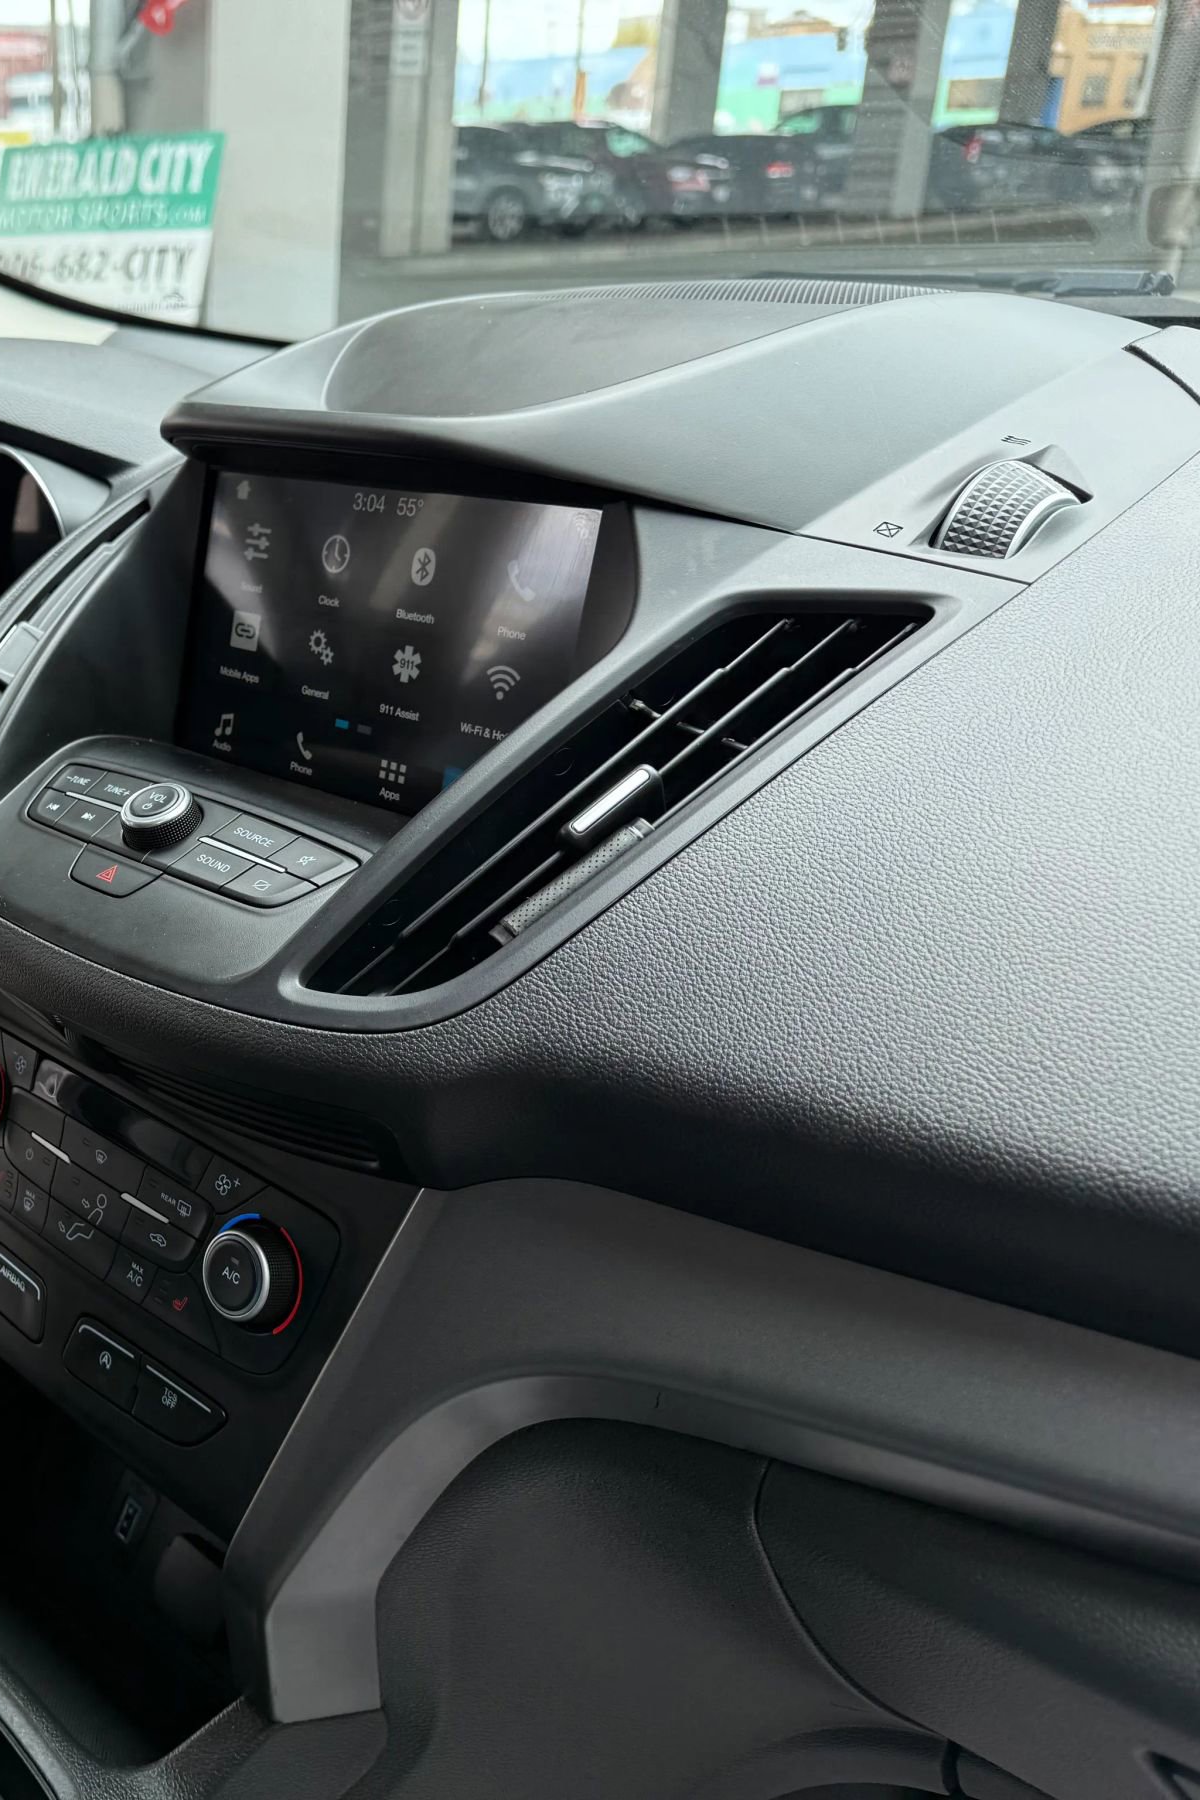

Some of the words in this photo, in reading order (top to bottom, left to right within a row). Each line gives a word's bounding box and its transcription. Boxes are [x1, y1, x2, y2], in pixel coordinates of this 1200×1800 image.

[5, 147, 138, 201] EMERALD
[138, 140, 215, 195] CITY
[352, 492, 386, 512] 3:04
[240, 581, 263, 593] Sound
[318, 595, 340, 607] Clock
[395, 608, 435, 624] Bluetooth
[497, 626, 527, 640] Phone
[400, 658, 415, 671] 911
[219, 666, 241, 680] Mobile
[241, 671, 260, 684] Apps
[301, 685, 330, 700] General
[379, 704, 395, 716] 911
[395, 708, 420, 722] Assist
[460, 722, 483, 736] Wi-Fi
[483, 729, 491, 739] &
[212, 738, 232, 752] Audio
[289, 760, 313, 776] Phone
[149, 791, 168, 803] VOL
[378, 787, 401, 802] Apps
[233, 827, 275, 848] SOURCE
[196, 854, 231, 873] SOUND
[161, 1192, 176, 1206] REAR
[131, 1261, 144, 1274] MAX
[221, 1266, 241, 1284] A/C
[0, 1266, 26, 1292] AIRBAG
[126, 1270, 144, 1287] A/C
[161, 1395, 178, 1409] OFF
